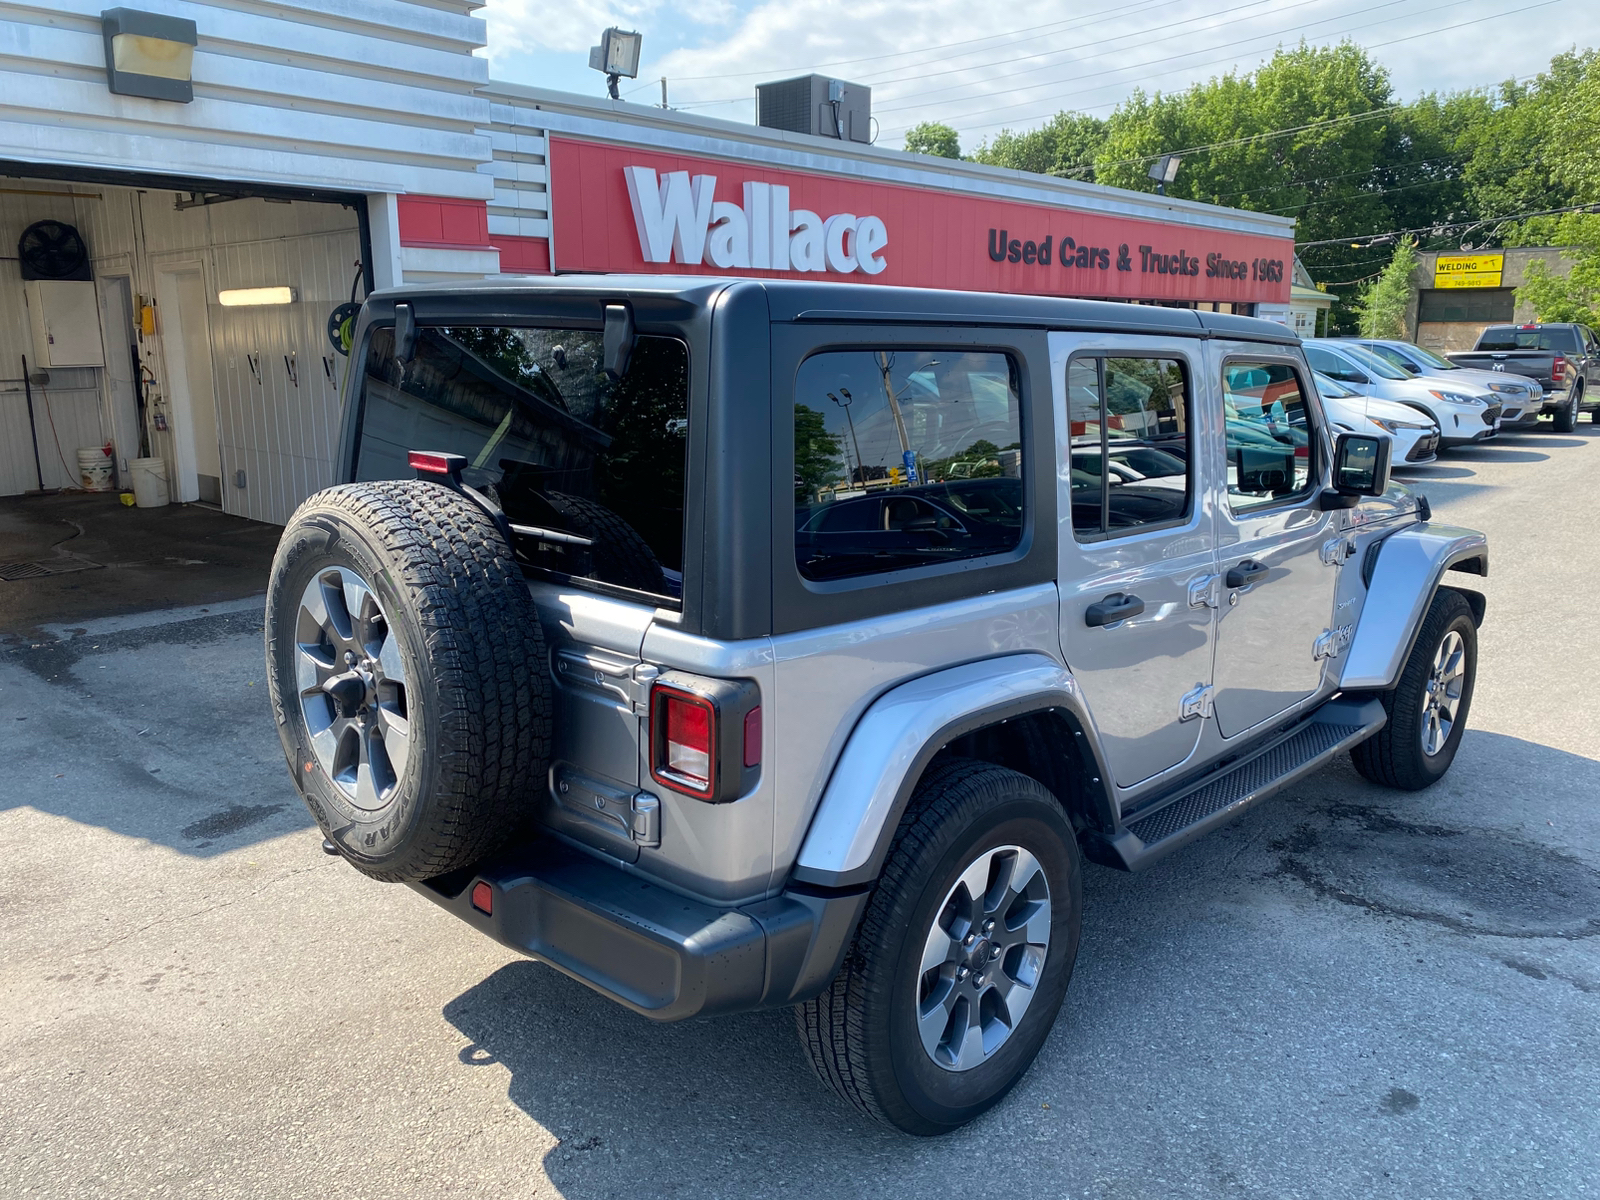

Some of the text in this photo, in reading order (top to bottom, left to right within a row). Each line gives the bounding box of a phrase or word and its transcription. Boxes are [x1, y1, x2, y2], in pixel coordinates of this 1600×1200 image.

[623, 165, 888, 275] Wallace
[988, 228, 1284, 283] Used Cars & Trucks Since 1963
[1438, 262, 1477, 270] WELDING
